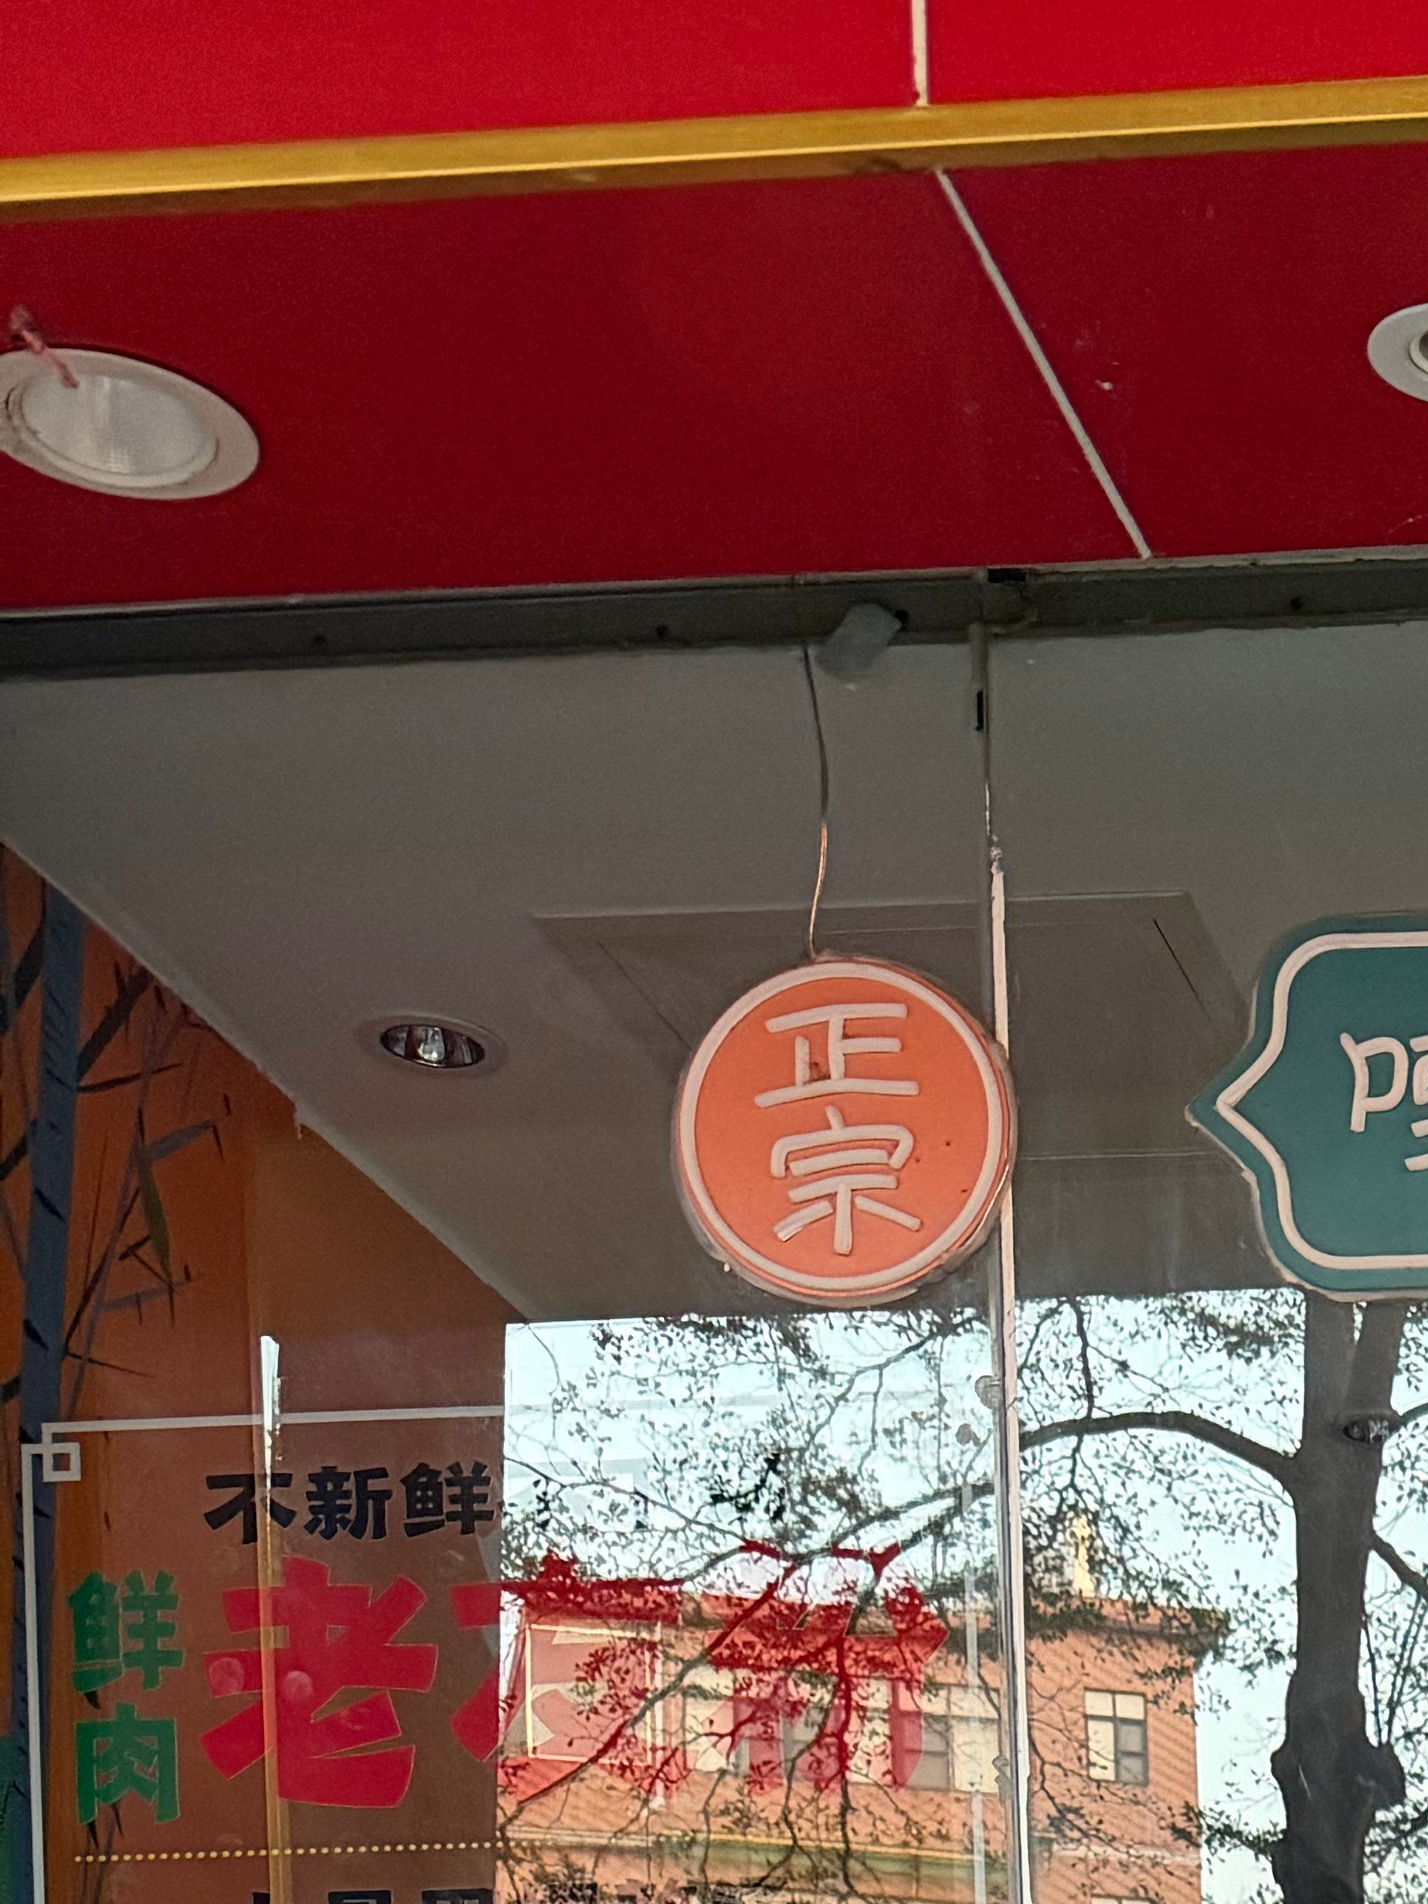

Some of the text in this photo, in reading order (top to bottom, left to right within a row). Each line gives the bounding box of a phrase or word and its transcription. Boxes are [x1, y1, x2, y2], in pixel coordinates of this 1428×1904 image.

[753, 1001, 923, 1257] 正宗
[67, 1538, 948, 1824] 鲜肉 老友粉
